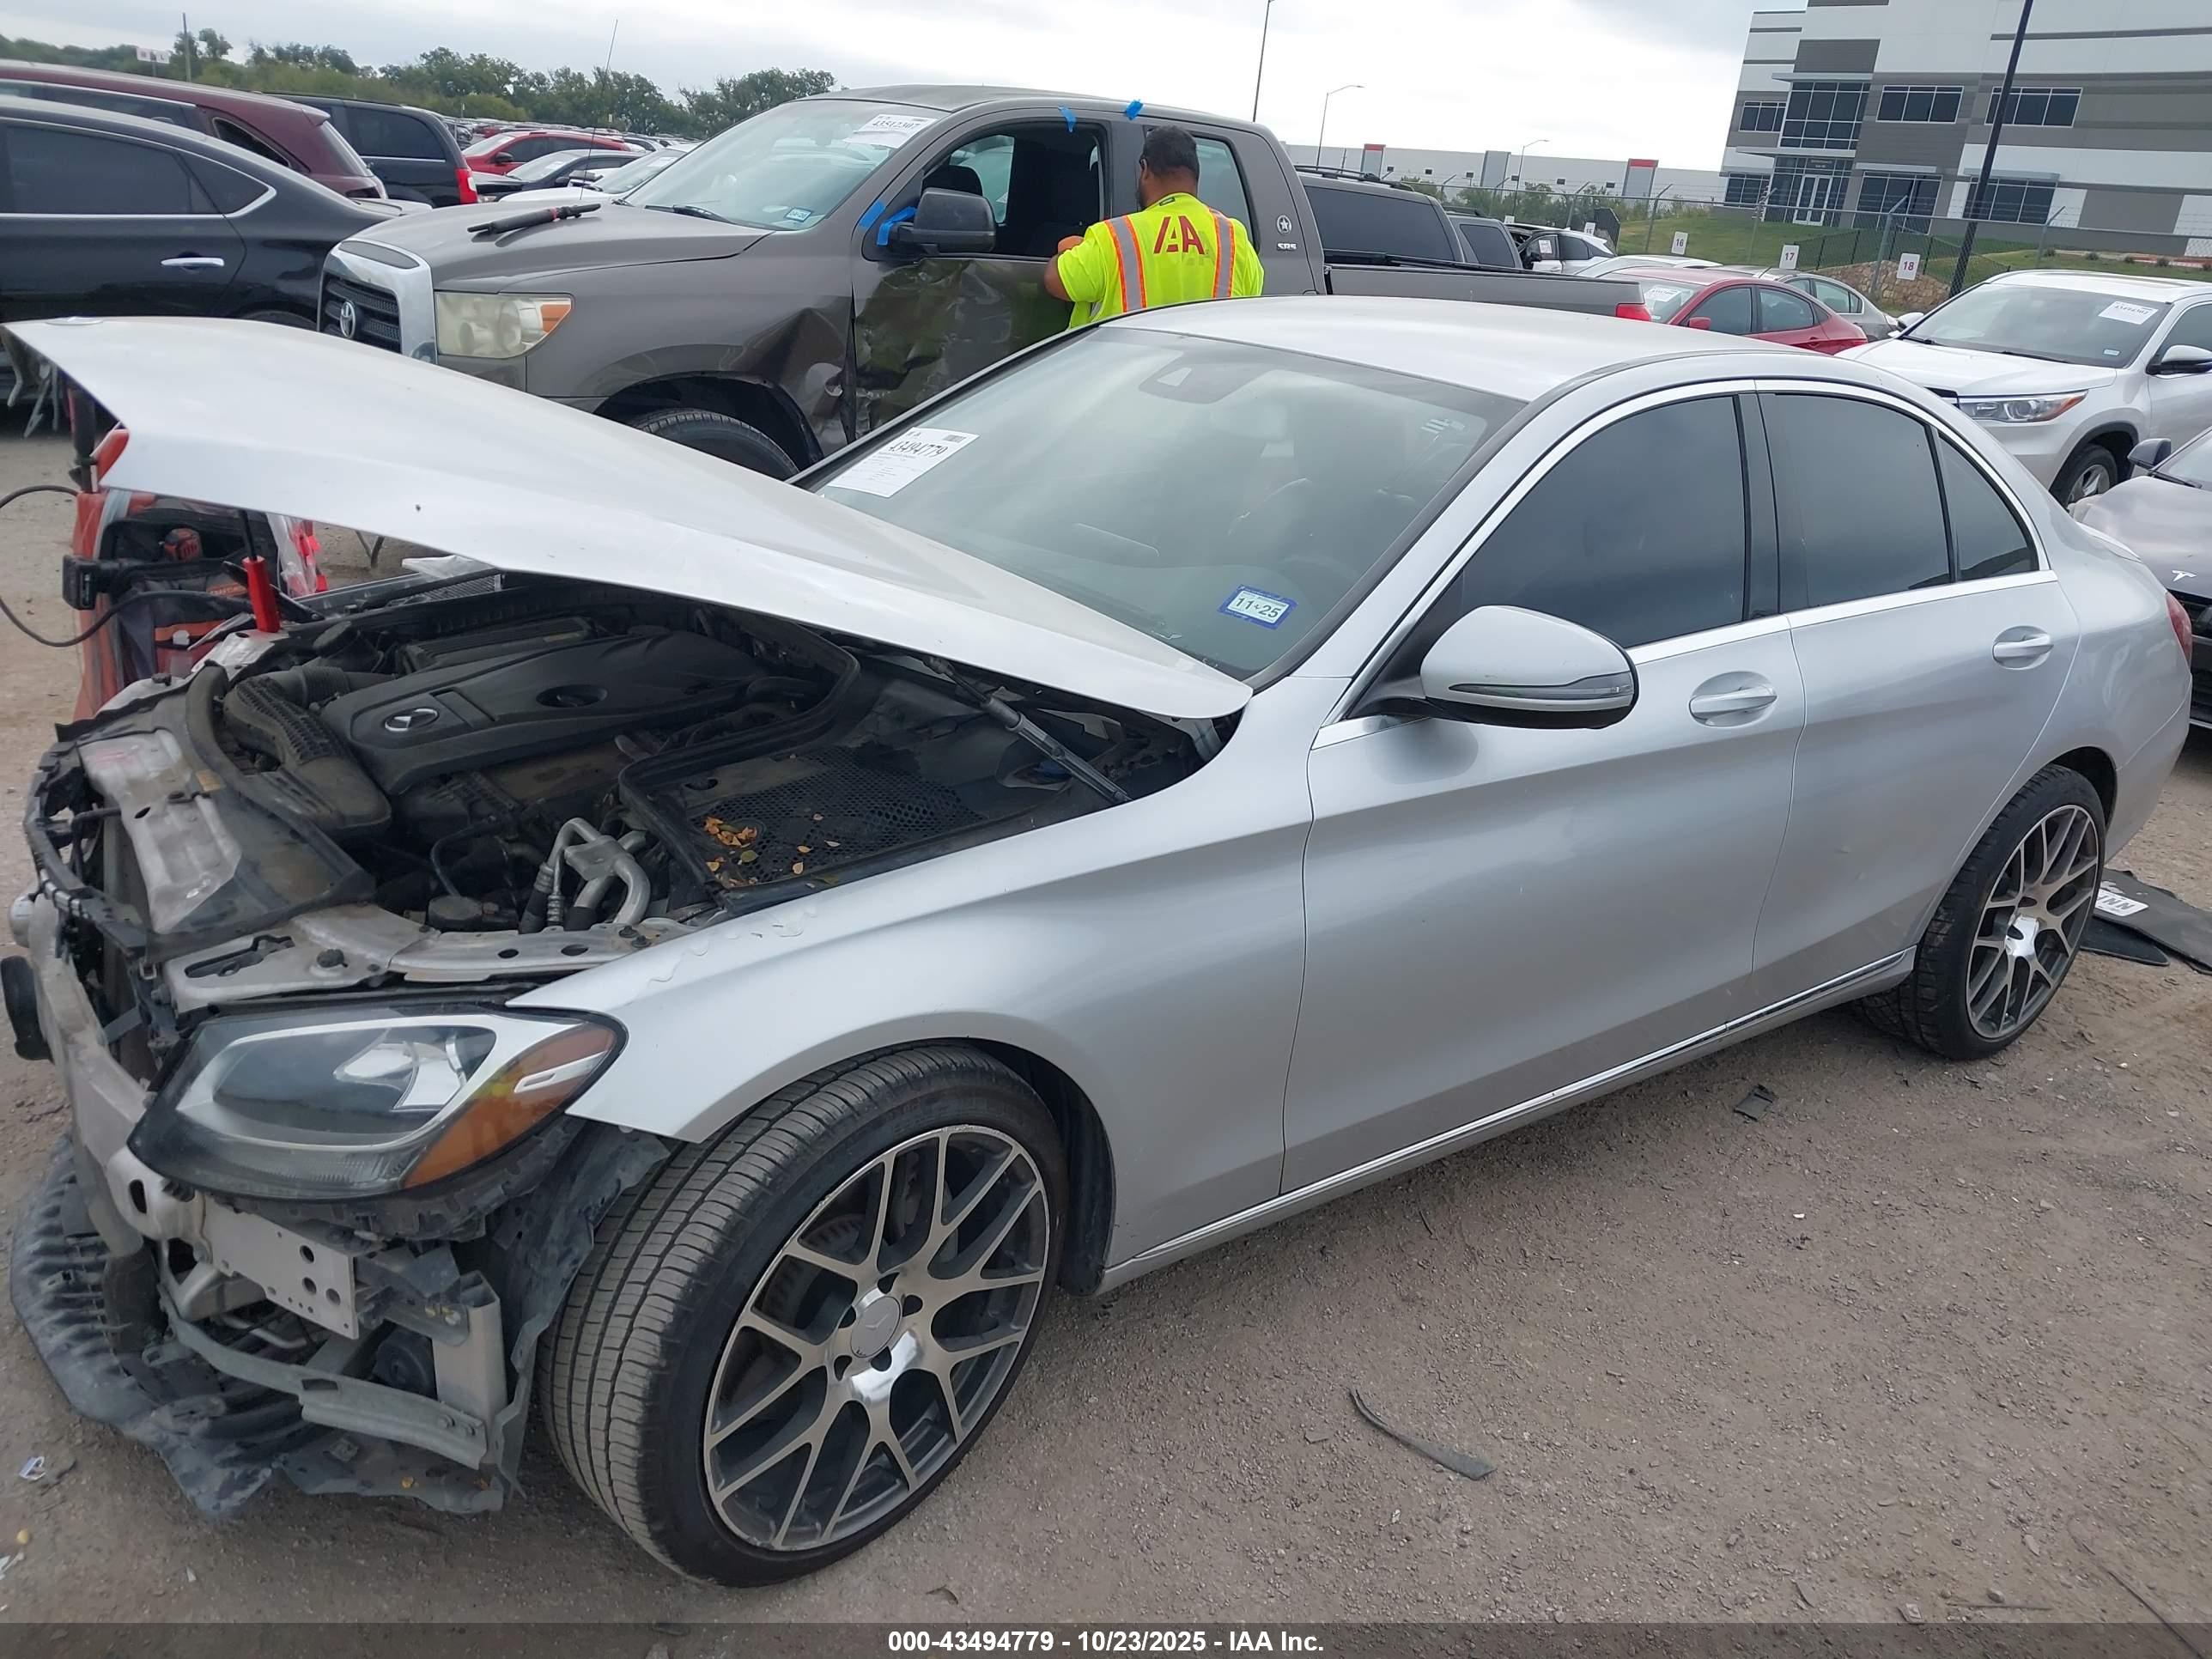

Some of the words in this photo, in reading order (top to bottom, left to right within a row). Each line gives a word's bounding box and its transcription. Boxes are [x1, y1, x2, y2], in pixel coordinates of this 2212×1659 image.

[1676, 238, 1684, 247] 16
[1785, 252, 1796, 261] 17
[1903, 260, 1915, 271] 18
